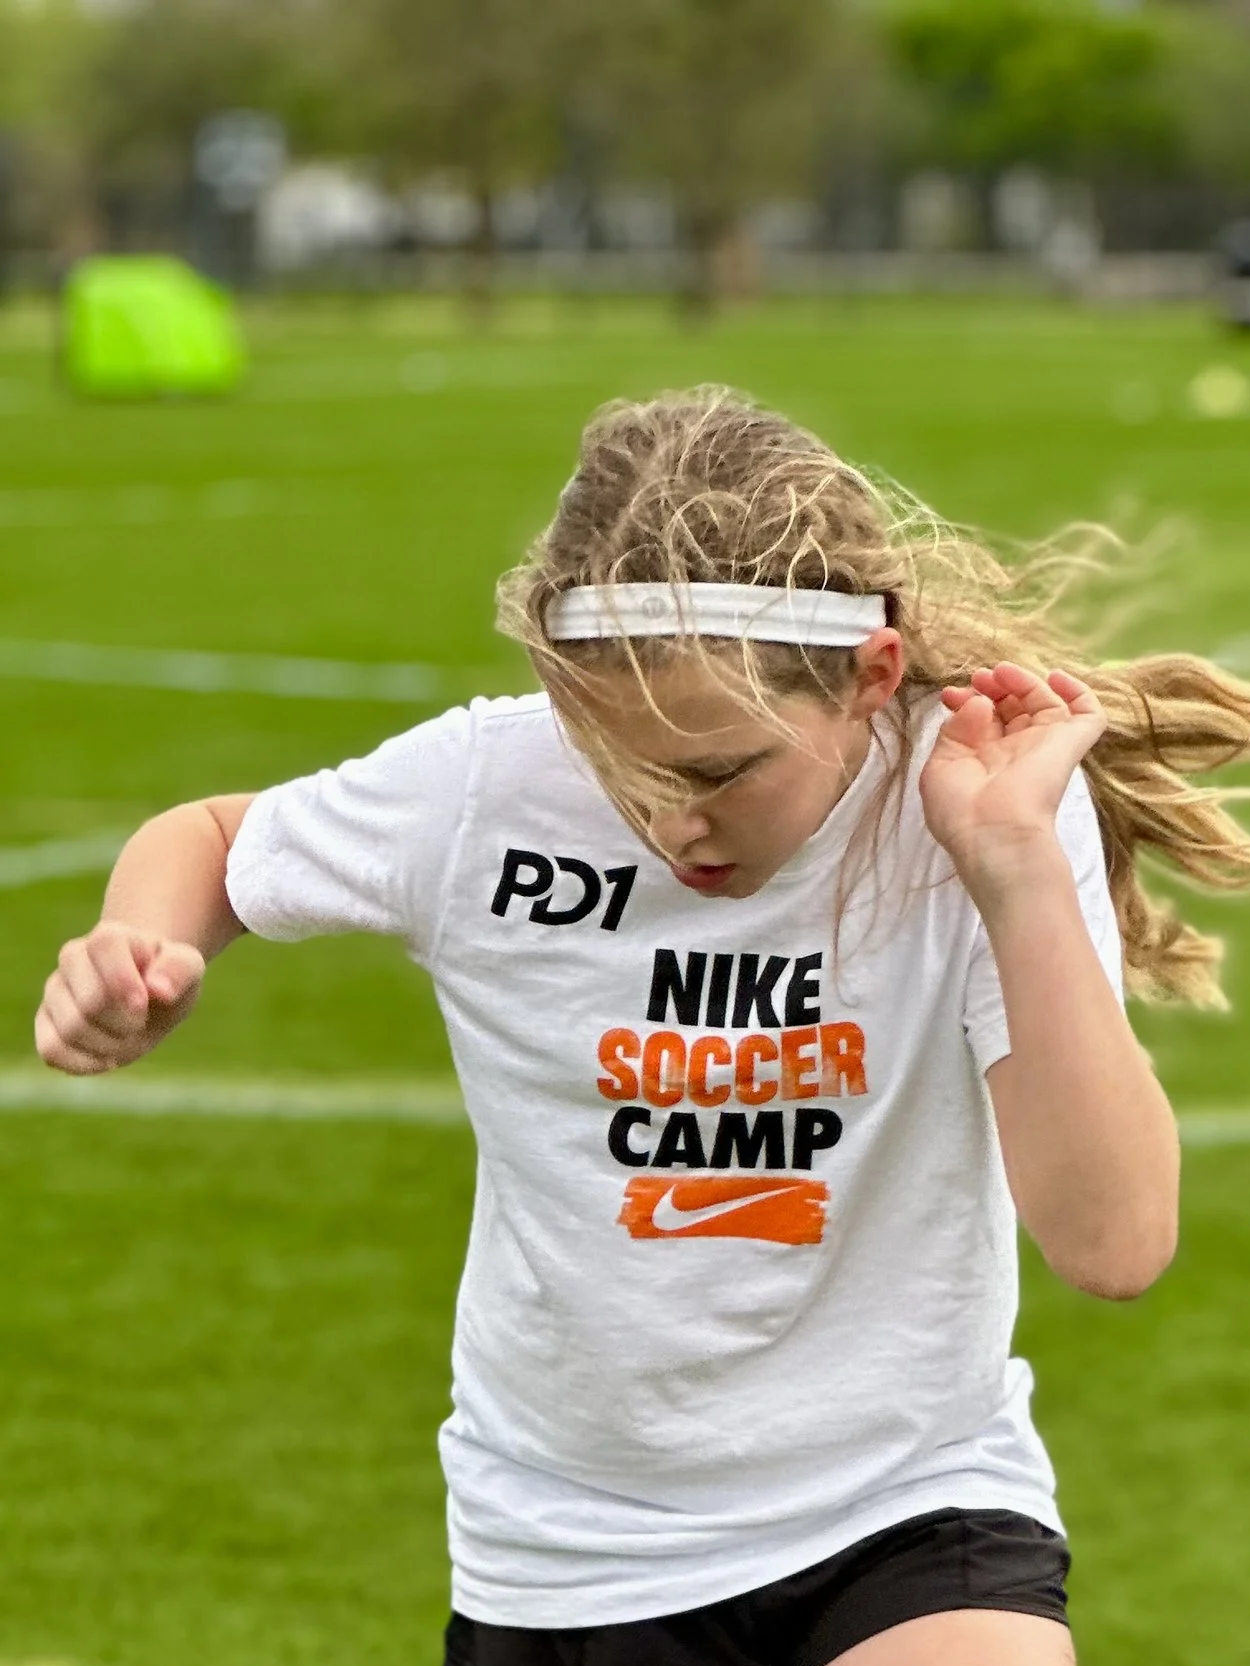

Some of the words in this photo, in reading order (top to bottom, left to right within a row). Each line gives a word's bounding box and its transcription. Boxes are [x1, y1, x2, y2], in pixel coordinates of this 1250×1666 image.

[491, 849, 638, 931] PD1
[646, 949, 823, 1028] NIKE
[597, 1022, 868, 1107] SOCCER
[608, 1106, 843, 1170] CAMP
